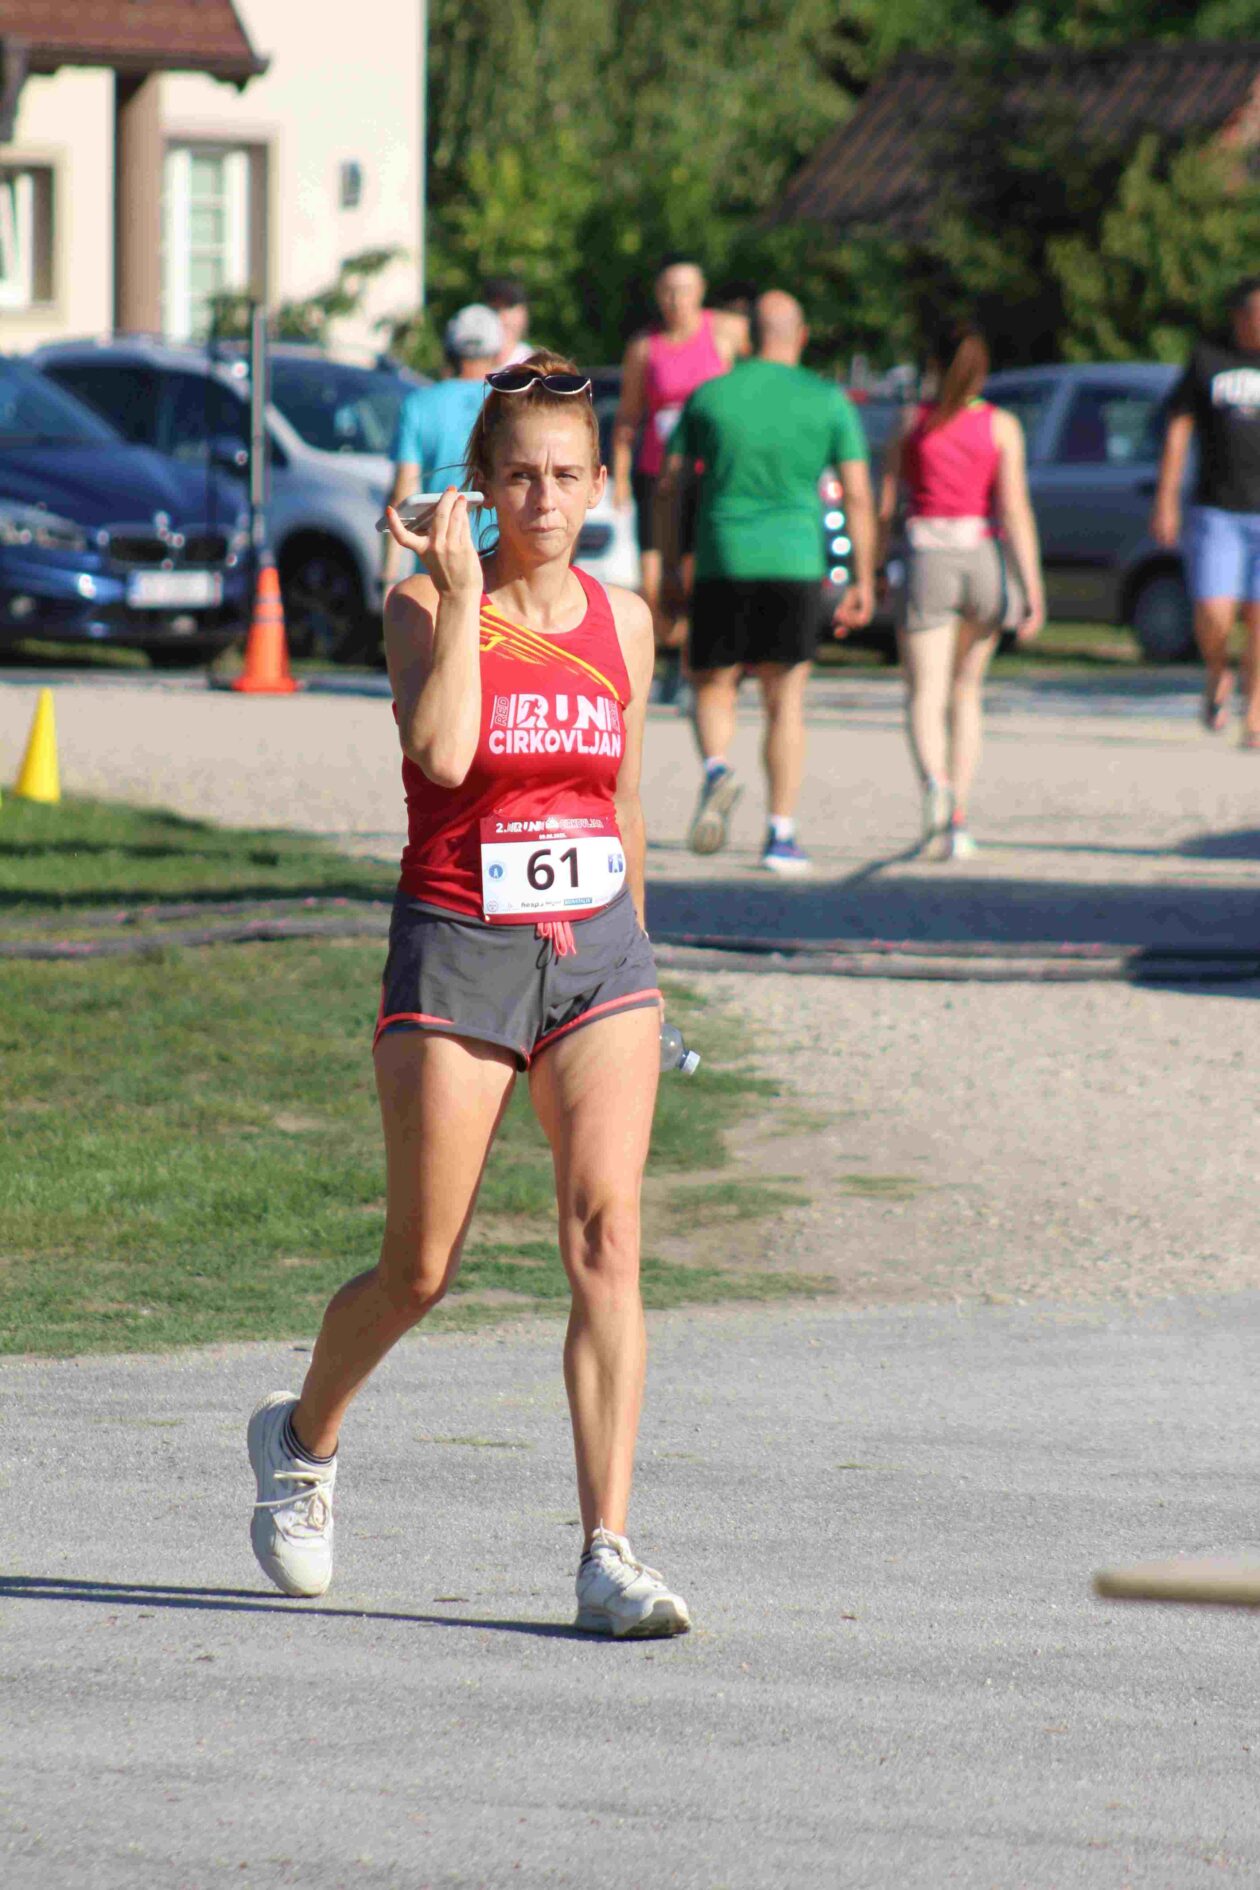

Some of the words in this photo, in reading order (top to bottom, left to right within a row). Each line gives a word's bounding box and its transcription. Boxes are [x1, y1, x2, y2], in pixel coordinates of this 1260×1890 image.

[516, 693, 607, 730] RUN
[488, 729, 621, 758] CIRKOVLJAN
[526, 846, 580, 891] 61
